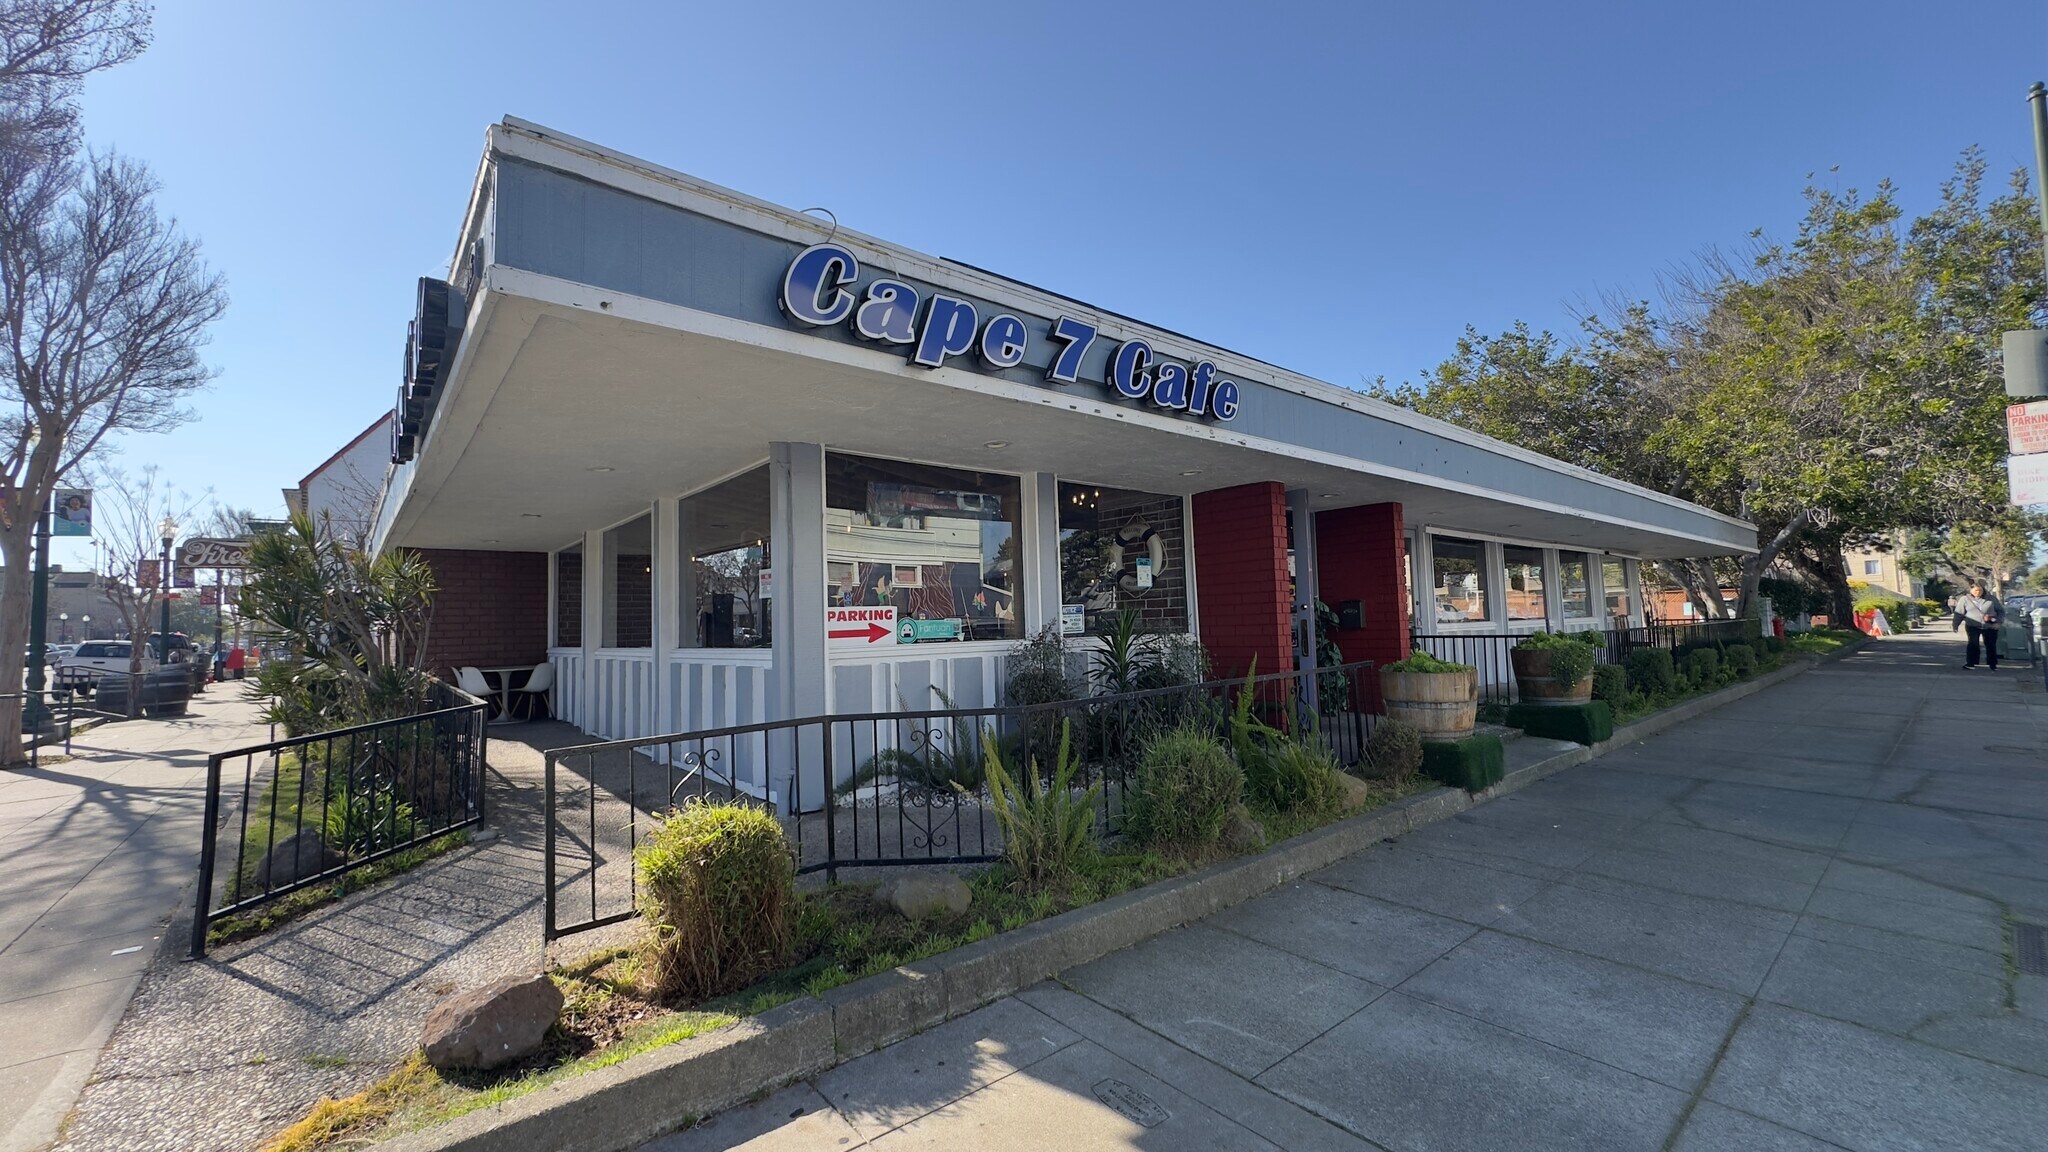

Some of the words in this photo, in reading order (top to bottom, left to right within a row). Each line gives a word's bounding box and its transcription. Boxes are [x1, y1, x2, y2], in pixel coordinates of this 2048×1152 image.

[780, 242, 1028, 368] Cape
[1047, 314, 1098, 385] 7
[1108, 338, 1240, 422] Cafe
[2009, 406, 2024, 417] NO
[2012, 414, 2048, 426] PARKIN
[828, 609, 893, 622] PARKING
